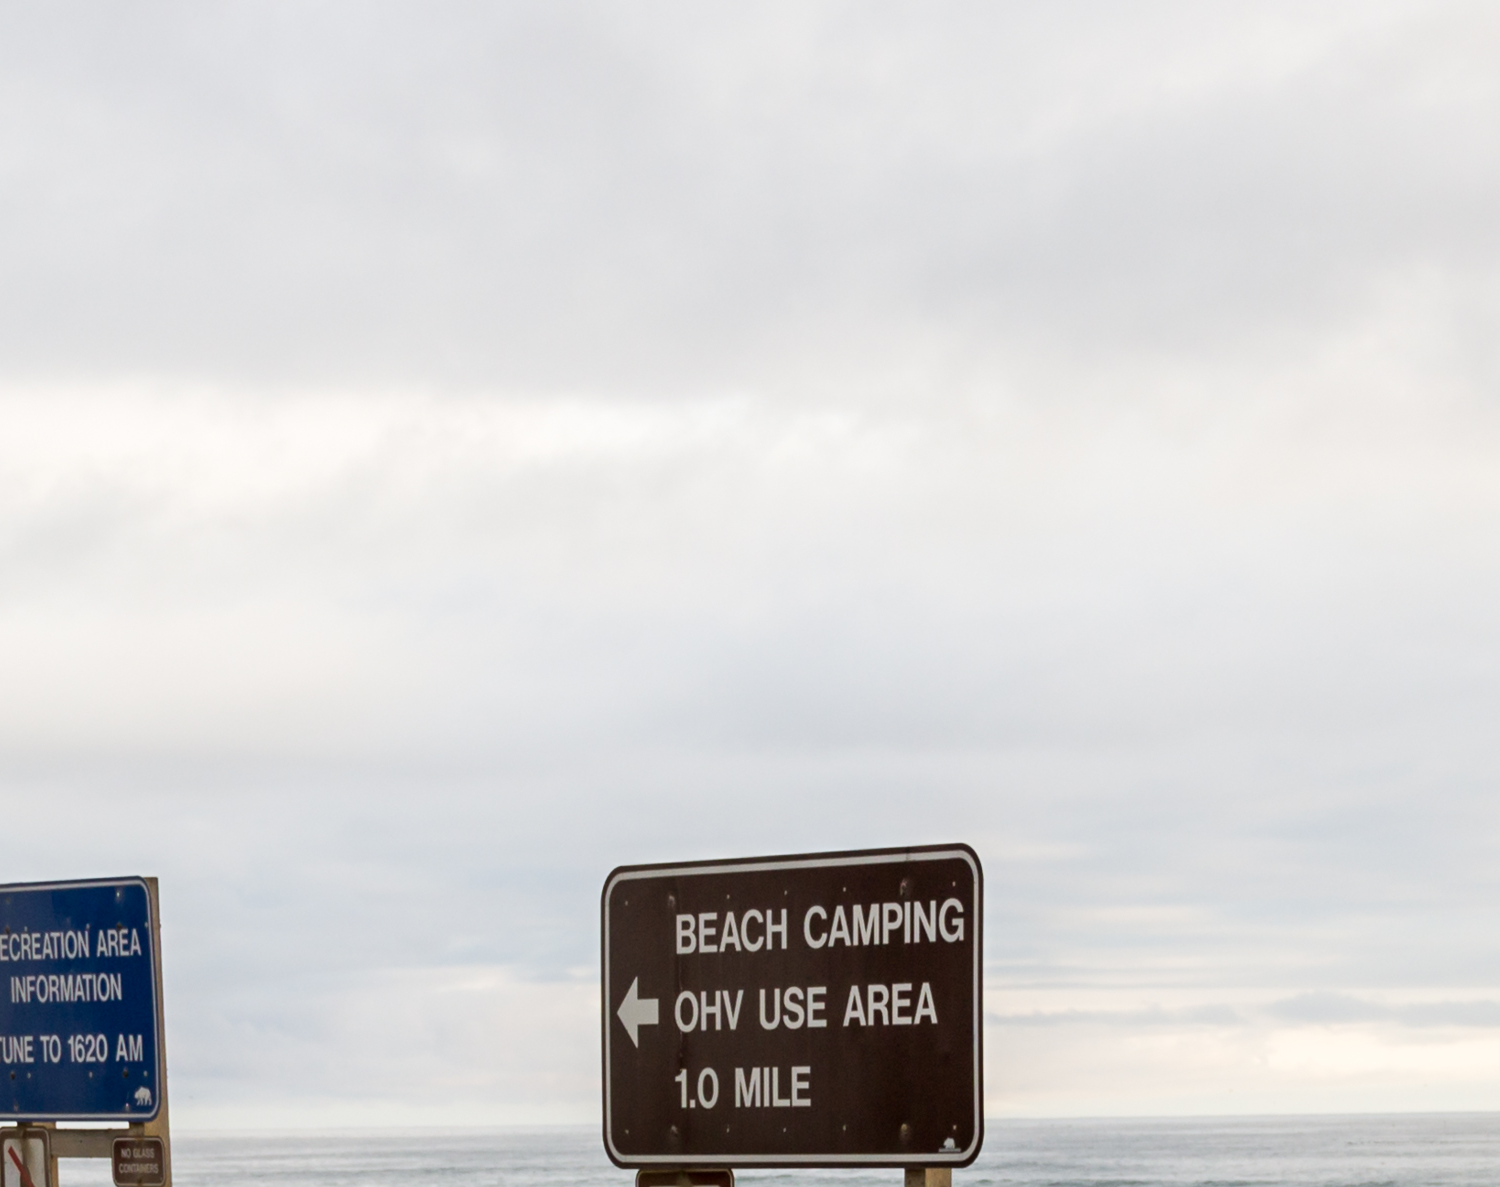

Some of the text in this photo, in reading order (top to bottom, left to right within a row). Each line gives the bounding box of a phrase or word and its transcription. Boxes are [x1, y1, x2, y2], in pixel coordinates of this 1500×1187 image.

[675, 897, 965, 955] BEACH CAMPING
[97, 928, 142, 957] AREA
[11, 973, 122, 1003] INFORMATION
[674, 982, 938, 1032] OHV USE AREA
[40, 1036, 61, 1063] TO
[68, 1035, 107, 1062] 1620
[116, 1034, 143, 1062] AM
[674, 1066, 812, 1110] 1.0 MILE
[121, 1148, 154, 1158] NO GLASS
[119, 1164, 159, 1173] CONTAINERS
